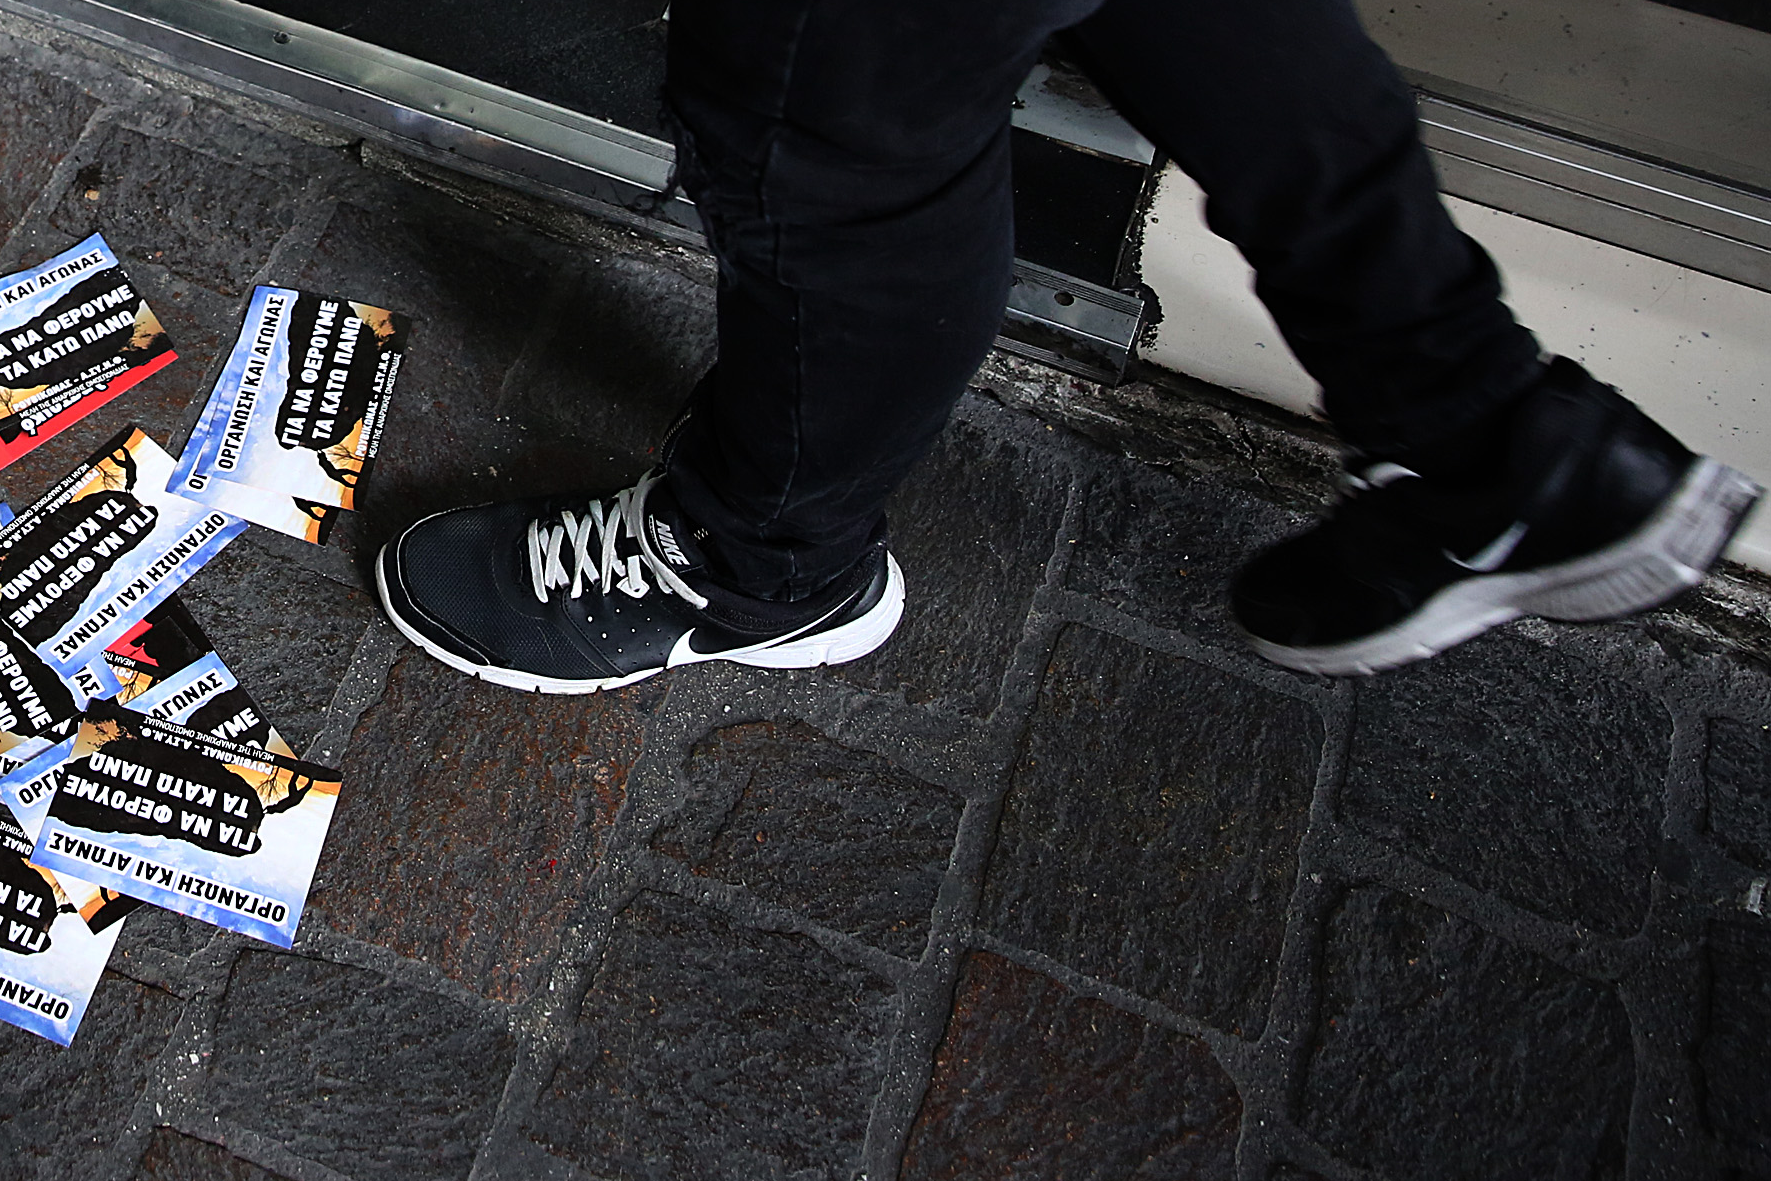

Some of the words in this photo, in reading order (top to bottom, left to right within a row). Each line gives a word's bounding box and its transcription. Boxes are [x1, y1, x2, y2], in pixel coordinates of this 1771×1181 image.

[3, 282, 34, 303] ΚΑΙ
[39, 252, 102, 287] ΑΓΩΝΑΣ
[10, 329, 42, 351] ΝΑ
[43, 284, 134, 334] ΦΕΡΟΥΜΕ
[27, 336, 81, 368] ΚΑΤΩ
[79, 310, 136, 344] ΠΑΝΩ
[300, 300, 338, 383] ΦΕΡΟΥΜΕ
[333, 316, 363, 364] ΠΑΝΩ
[218, 390, 255, 469] ΟΡΓΑΝΩΣΗ
[244, 359, 264, 386] ΚΑΙ
[254, 297, 283, 356] ΑΓΩΝΑΣ
[319, 368, 348, 414] ΚΑΤΩ
[290, 389, 314, 412] ΝΑ
[281, 417, 306, 445] ΓΙΑ
[311, 419, 334, 438] ΤΑ
[60, 476, 74, 487] ΤΗΣ
[70, 462, 90, 478] ΜΕΛΗ
[30, 484, 62, 512] ΑΝΑΡΧΙΚΗΣ
[45, 467, 100, 513] ΡΟΥΒΙΚΩΝΑΣ
[94, 498, 126, 520] ΤΑ
[118, 501, 155, 534] ΓΙΑ
[49, 516, 101, 558] ΚΑΤΩ
[91, 531, 124, 557] ΝΑ
[146, 513, 224, 581] ΟΡΓΑΝΩΣΗ
[655, 519, 691, 566] NIKE
[8, 556, 95, 628] ΦΕΡΟΥΜΕ
[116, 578, 149, 607] ΚΑΙ
[53, 603, 116, 659] ΑΓΩΝΑΣ
[143, 715, 195, 737] ΟΜΟΣΠΟΝΔΙΑΣ
[195, 731, 237, 750] ΑΝΑΡΧΙΚΗΣ
[201, 745, 275, 776] ΡΟΥΒΙΚΩΝΑΣ
[236, 744, 250, 755] ΤΗΣ
[252, 749, 274, 761] ΜΕΛΗ
[88, 750, 152, 786] ΠΑΝΩ
[62, 774, 172, 823] ΦΕΡΟΥΜΕ
[156, 772, 216, 807] ΚΑΤΩ
[223, 792, 248, 818] ΤΑ
[180, 810, 212, 837] ΝΑ
[219, 822, 256, 851] ΓΙΑ
[49, 832, 131, 871] ΑΓΩΝΑΣ
[135, 860, 173, 886] ΚΑΙ
[16, 889, 42, 917] ΤΑ
[177, 874, 285, 921] ΟΡΓΑΝΩΣΗ
[8, 920, 46, 951] ΓΙΑ
